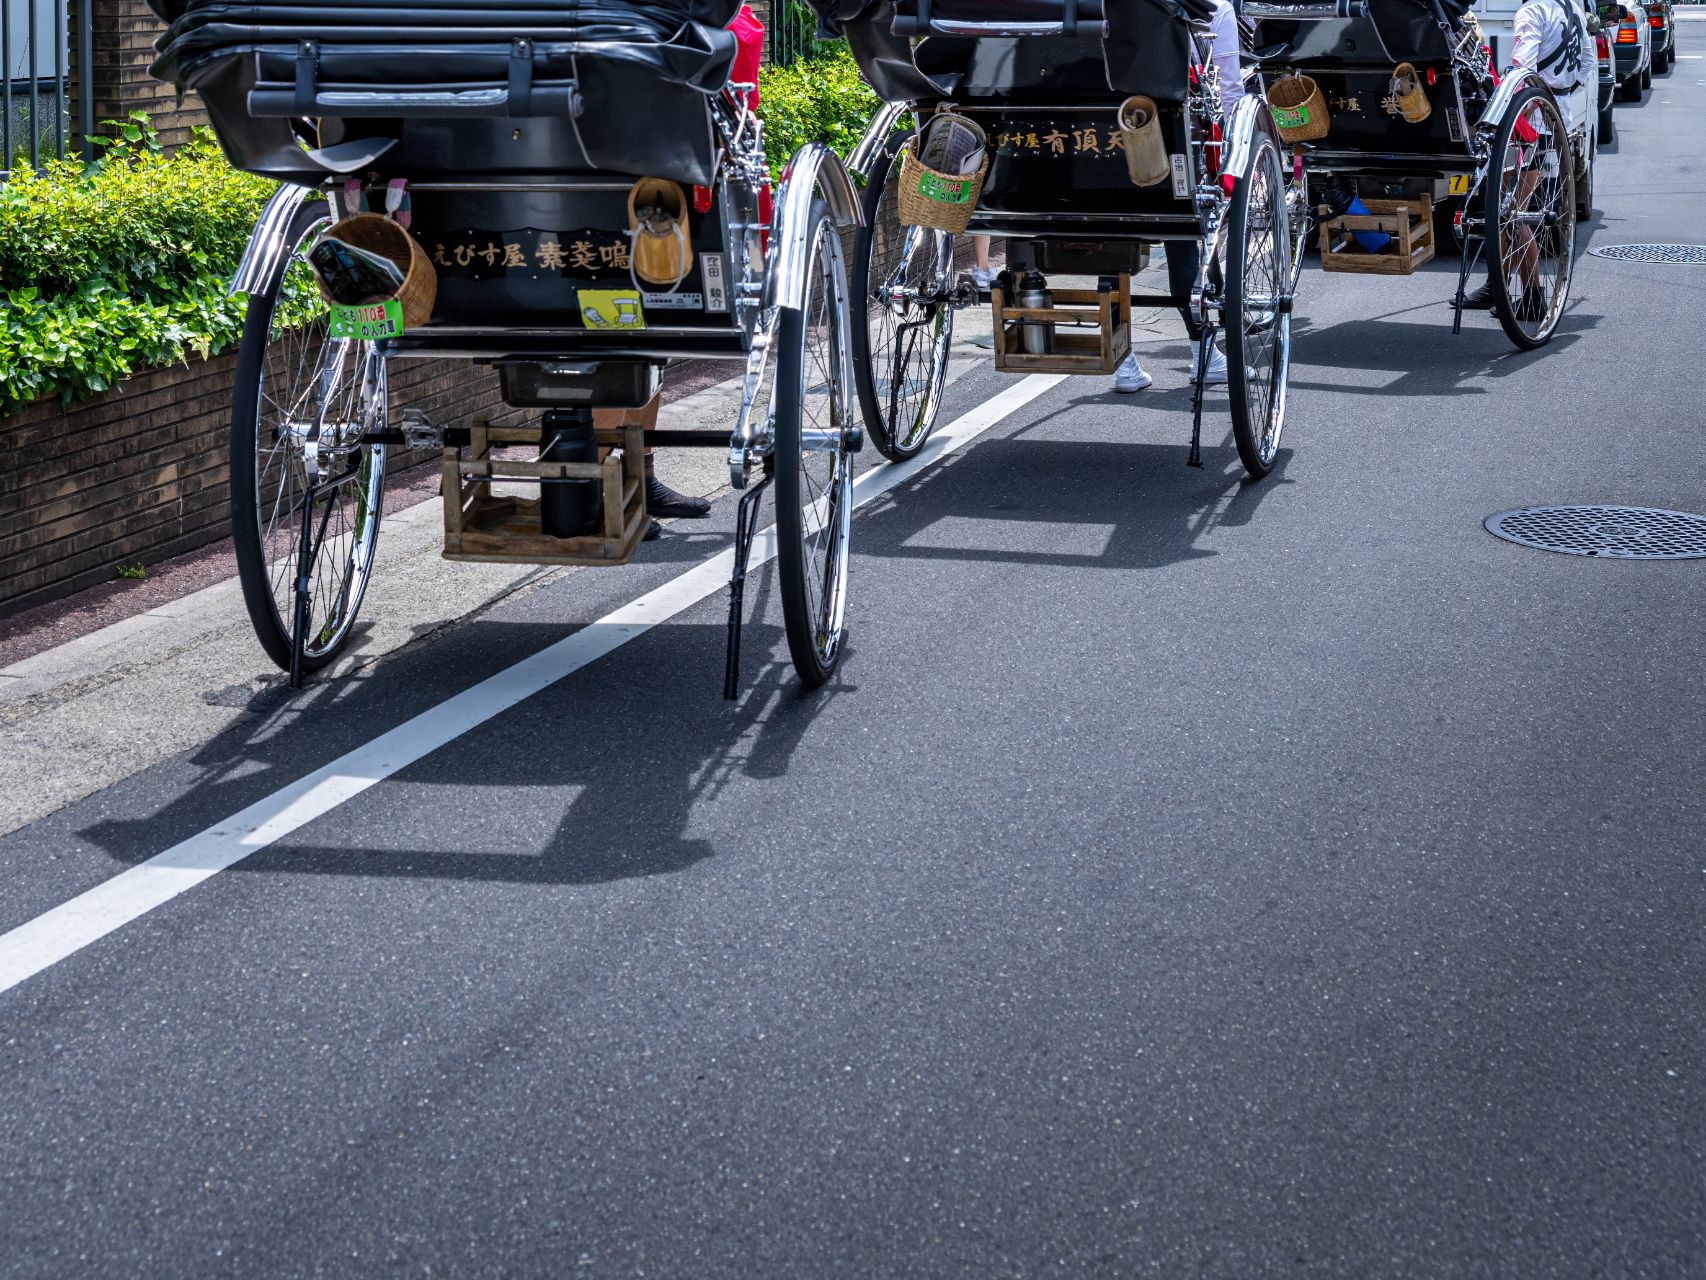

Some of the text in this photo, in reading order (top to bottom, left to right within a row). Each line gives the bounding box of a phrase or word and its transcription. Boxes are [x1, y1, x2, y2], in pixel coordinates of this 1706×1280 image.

[1328, 97, 1361, 111] す屋
[1042, 128, 1125, 154] 有頂天
[433, 241, 528, 268] えびす屋
[361, 319, 395, 336] の人力車
